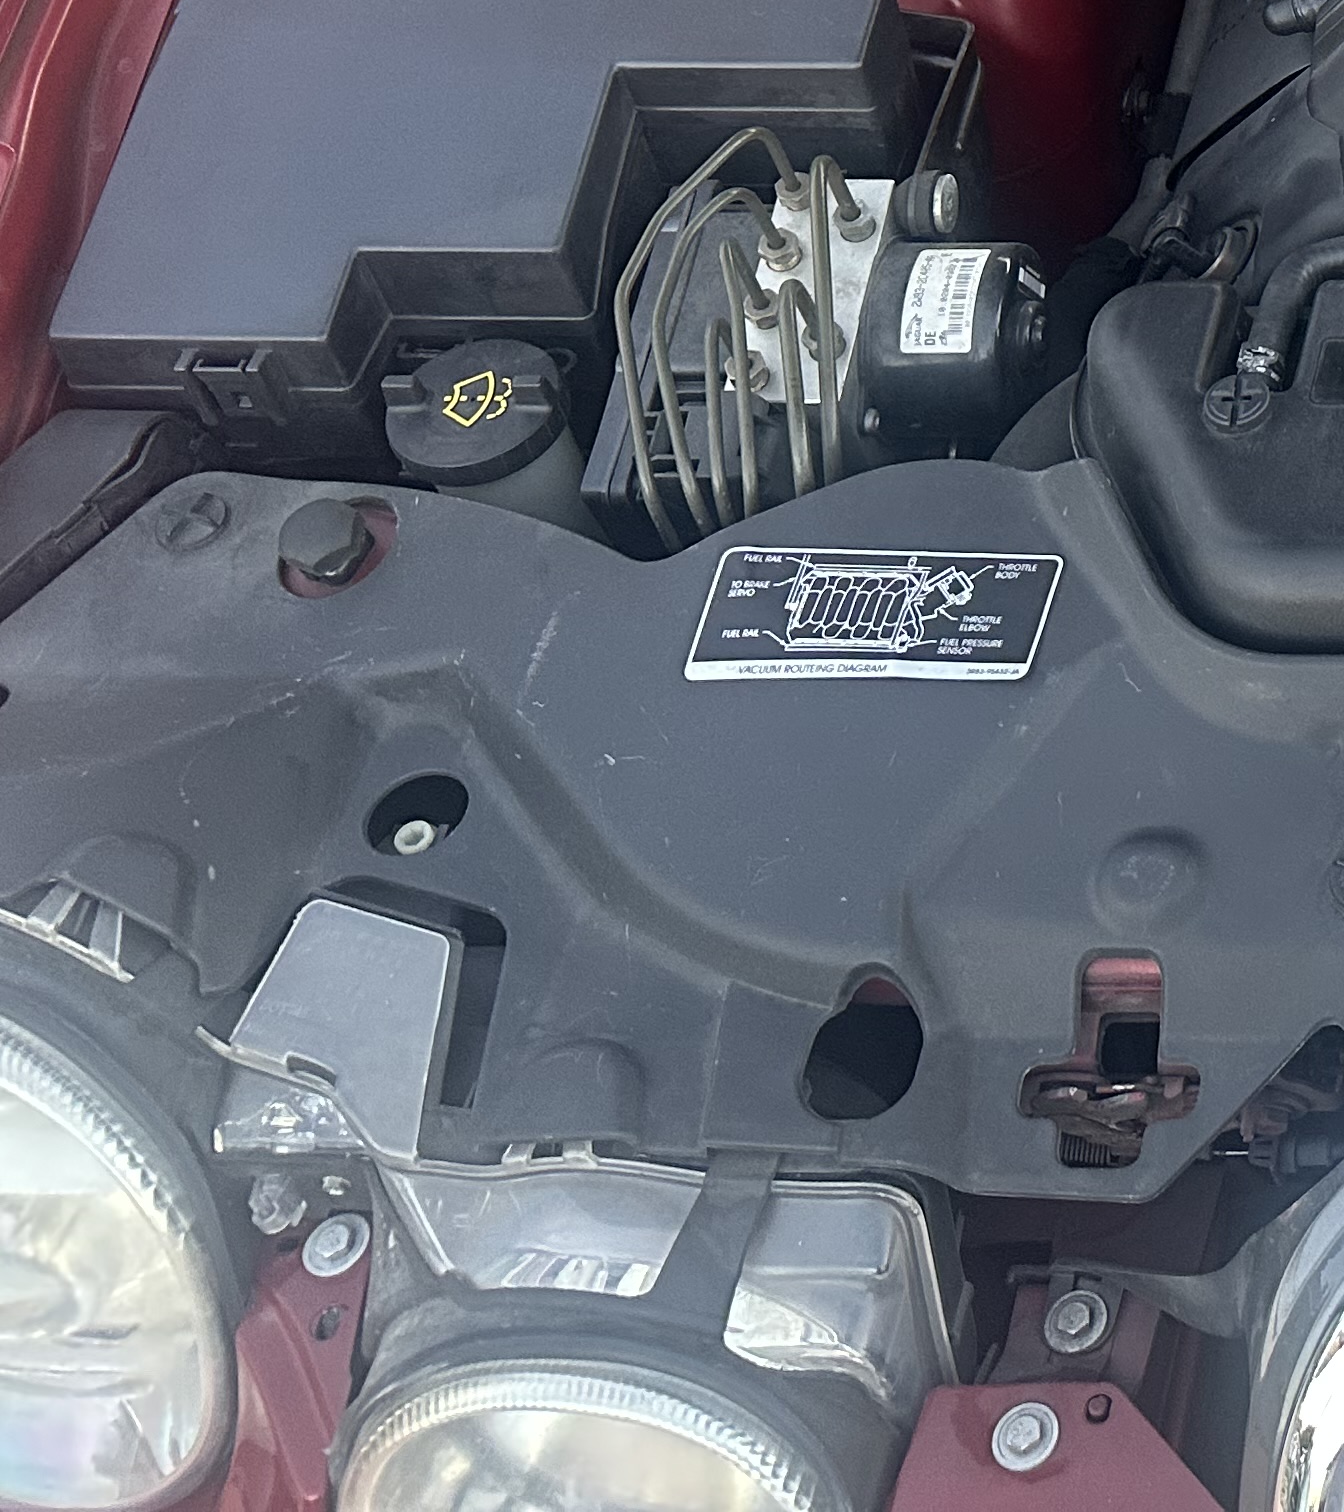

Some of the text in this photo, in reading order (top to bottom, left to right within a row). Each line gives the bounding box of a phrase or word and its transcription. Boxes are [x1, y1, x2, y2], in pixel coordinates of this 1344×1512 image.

[924, 331, 937, 345] DE
[743, 554, 783, 563] FUEL RAIL
[998, 563, 1039, 573] THROTTLE
[994, 572, 1021, 580] BODY
[731, 580, 771, 589] TO BRAKE
[727, 588, 757, 598] SERVO
[961, 615, 1003, 625] THROTTLE
[958, 624, 992, 632] ELBOW
[721, 629, 760, 638] FUEL RAIL
[939, 637, 1004, 648] FUEL PRESSURE
[936, 647, 973, 655] SENSOR
[738, 665, 782, 675] VACUUM
[836, 664, 888, 674] DIAGRAM
